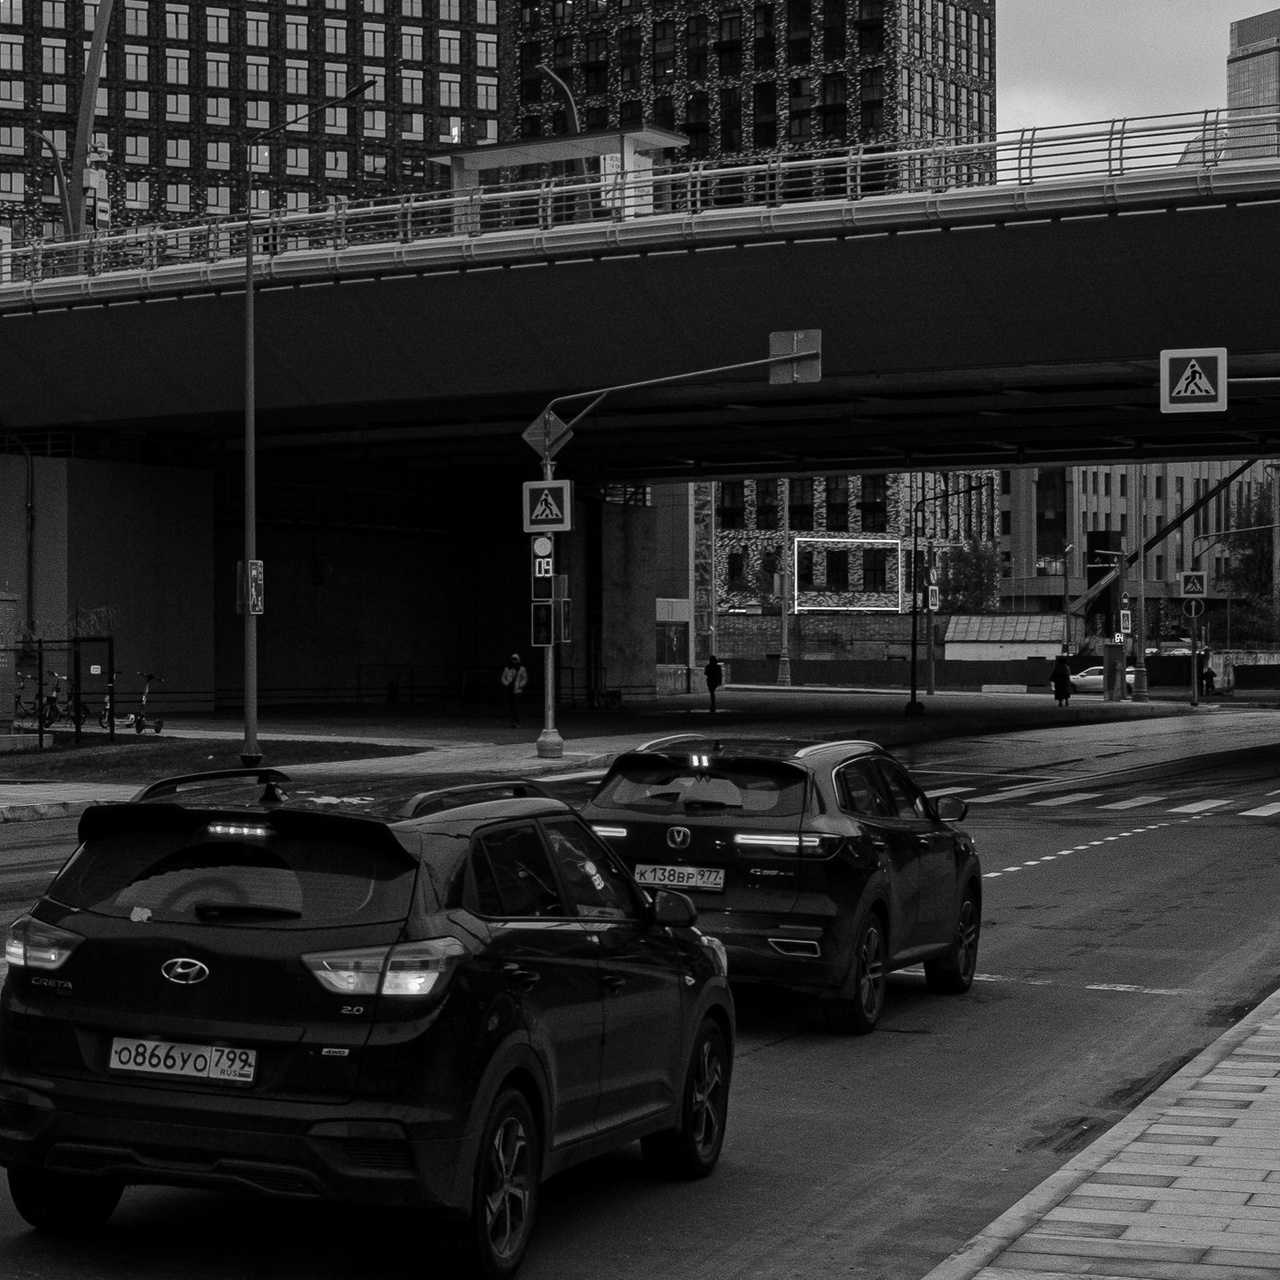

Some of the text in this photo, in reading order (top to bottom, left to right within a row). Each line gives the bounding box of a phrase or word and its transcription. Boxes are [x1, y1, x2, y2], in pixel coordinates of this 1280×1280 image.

[535, 558, 553, 577] 09
[639, 867, 720, 883] К138ВР 977
[31, 976, 73, 990] CRETA
[118, 1043, 250, 1072] О866УО 799
[219, 1068, 238, 1077] RUS
